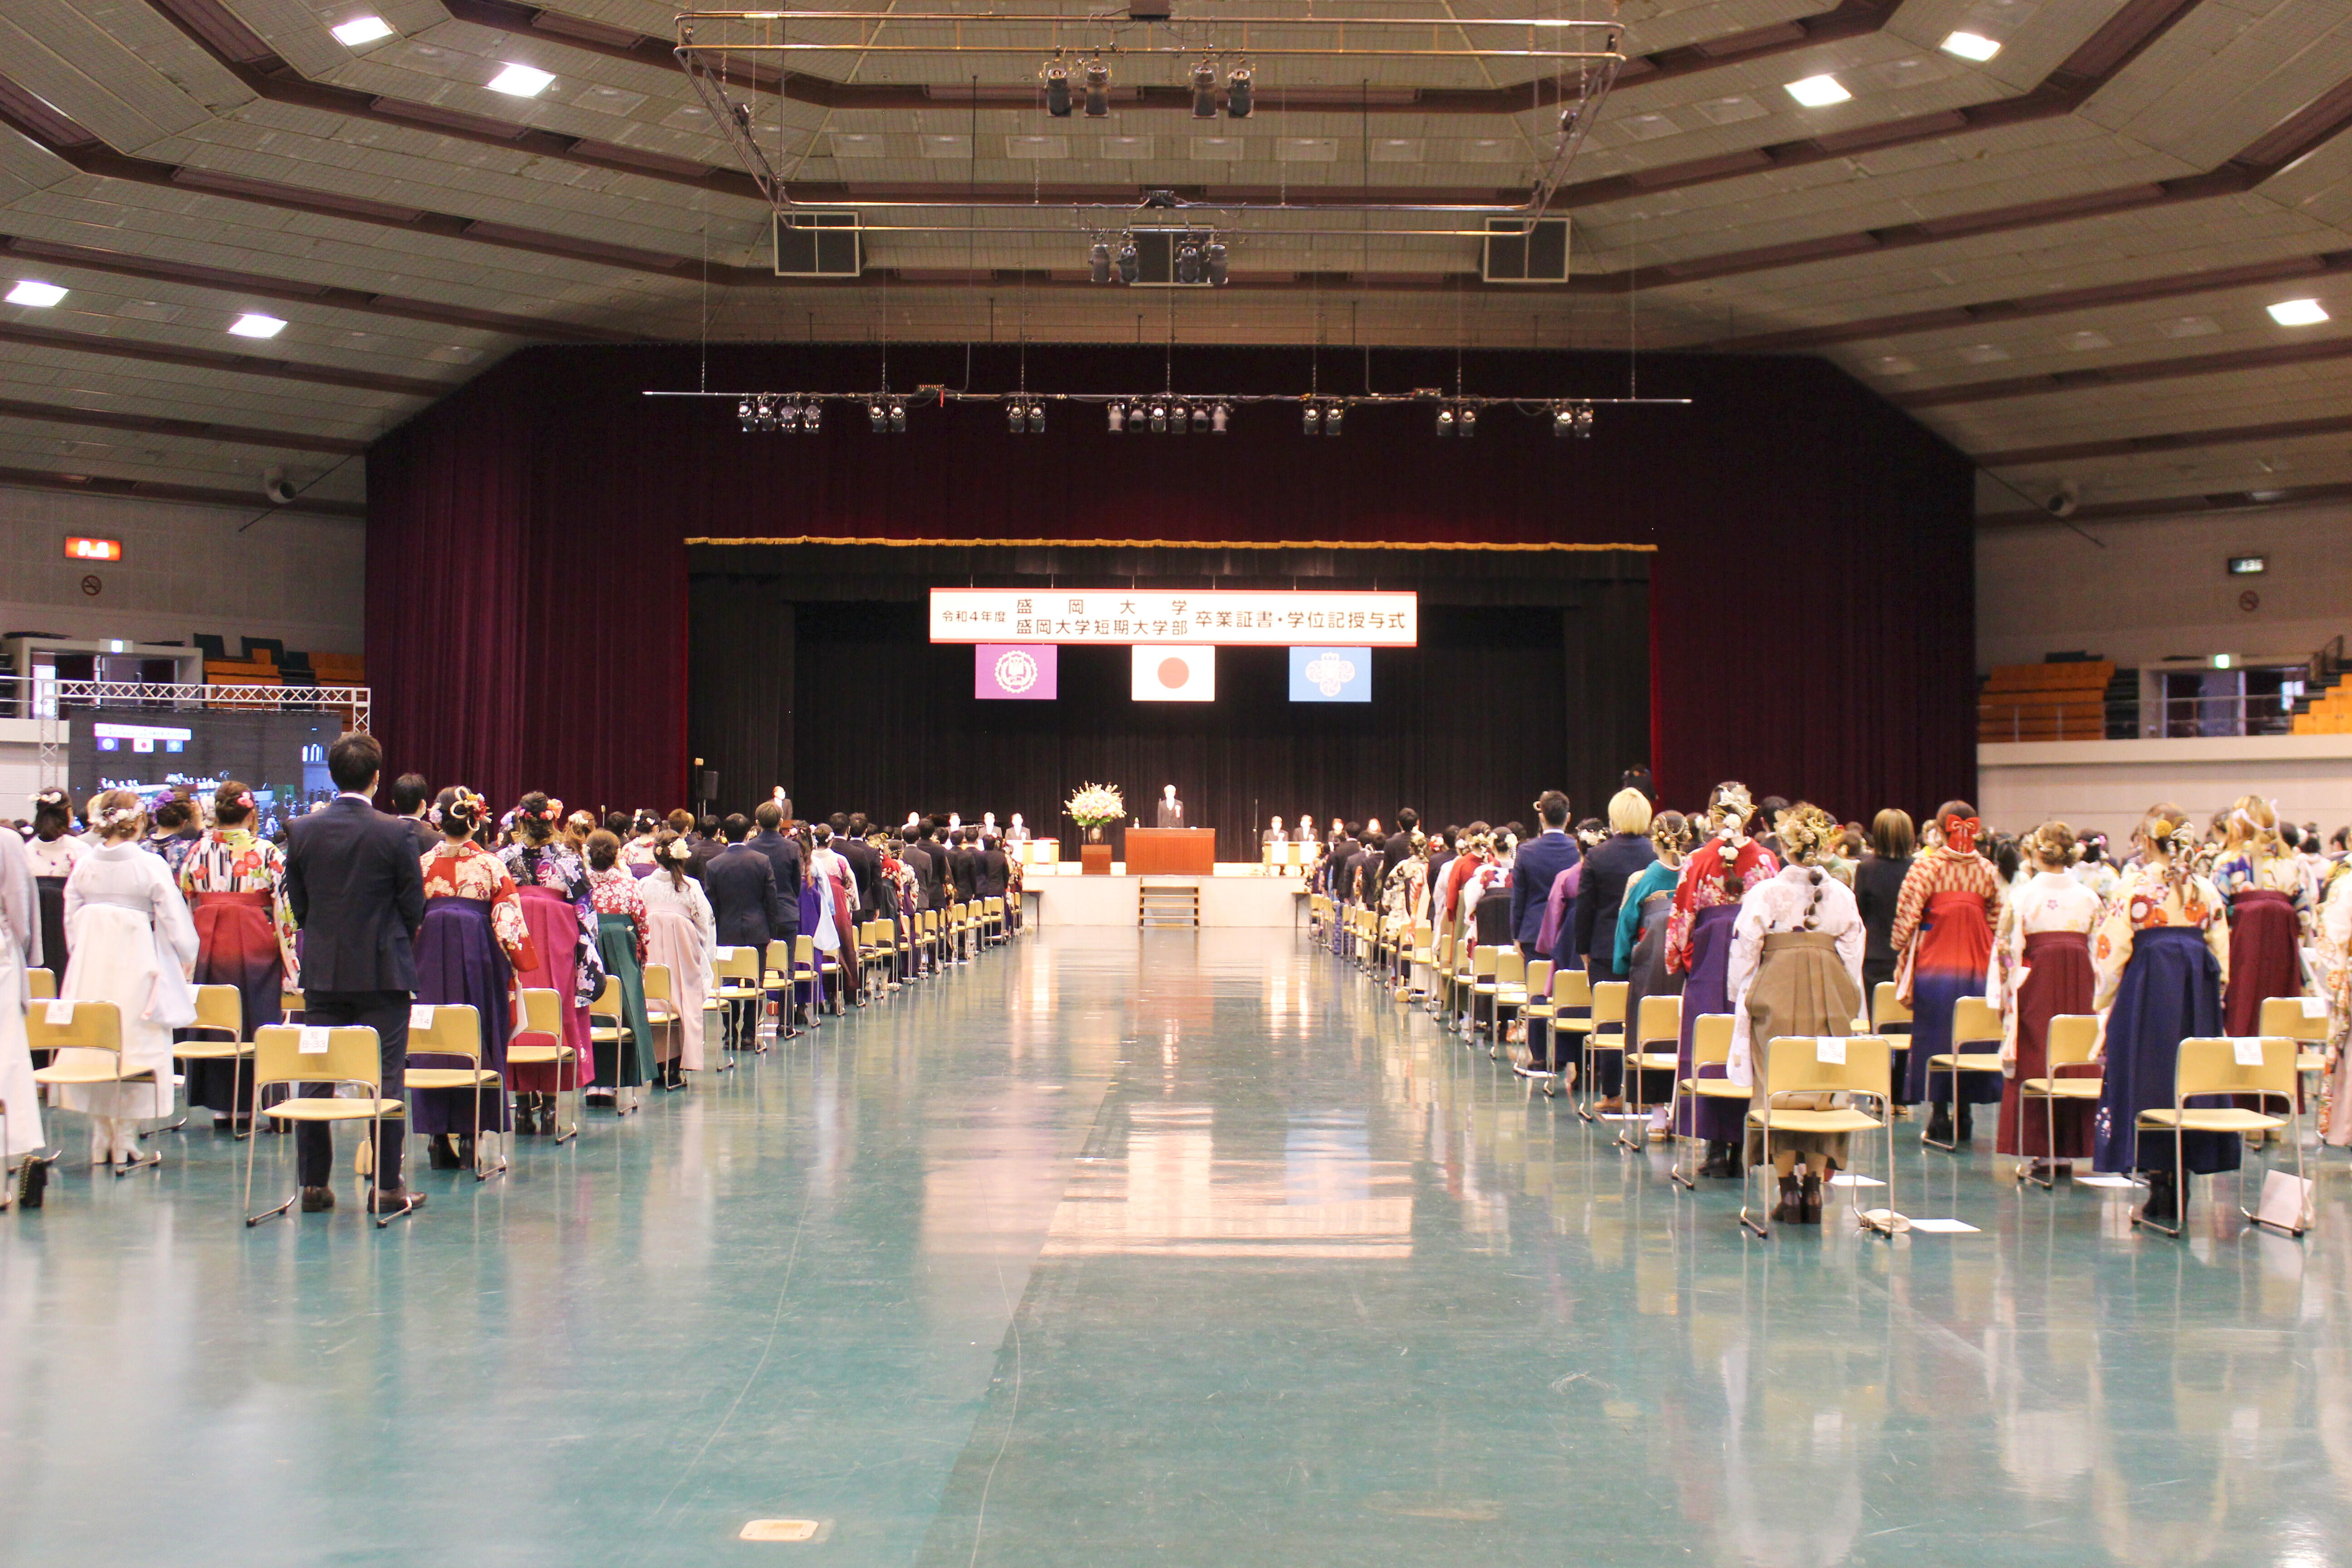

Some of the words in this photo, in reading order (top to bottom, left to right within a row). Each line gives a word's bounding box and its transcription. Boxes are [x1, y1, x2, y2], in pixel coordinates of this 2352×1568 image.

[1016, 599, 1187, 614] 盛岡大学
[942, 611, 1006, 622] 令和4年度
[1195, 610, 1406, 628] 卒業証書・学位記授与式
[1016, 619, 1187, 635] 盛岡大学短期大学部
